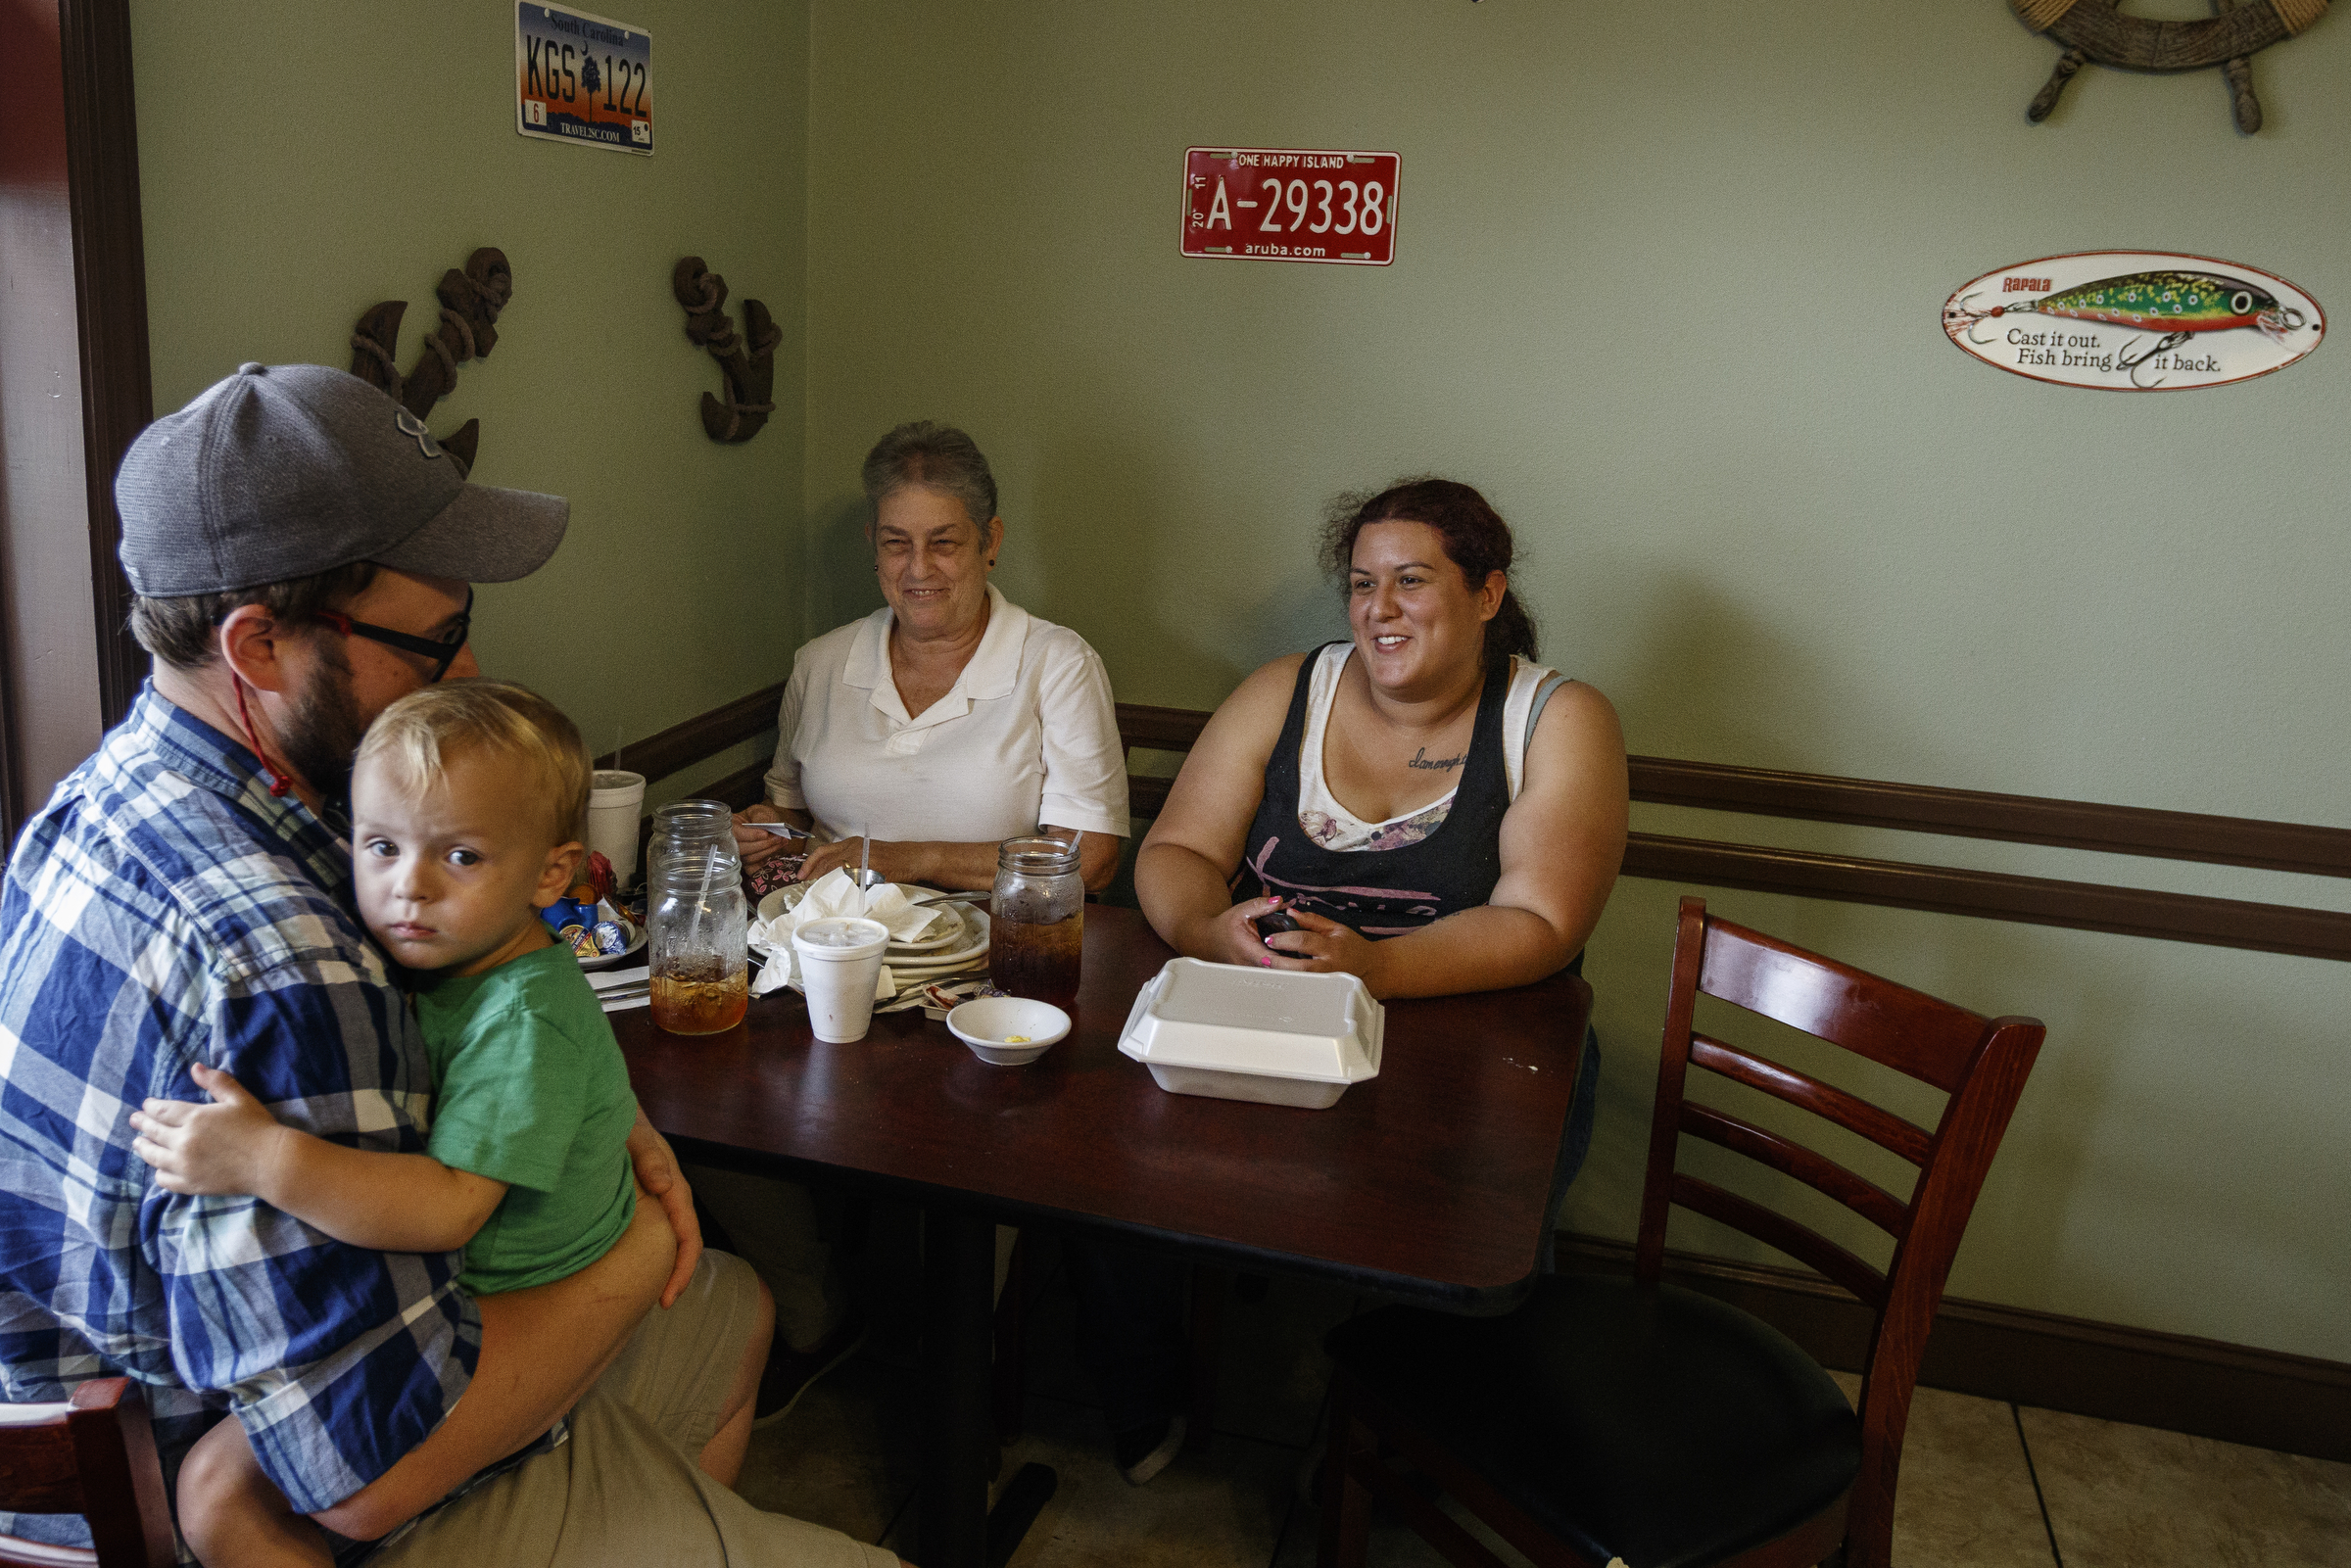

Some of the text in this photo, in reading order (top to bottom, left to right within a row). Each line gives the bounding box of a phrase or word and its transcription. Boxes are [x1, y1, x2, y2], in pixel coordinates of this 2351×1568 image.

[551, 14, 624, 47] South Carolina
[527, 34, 648, 118] KGS 122
[533, 103, 540, 122] 6
[560, 122, 620, 143] TRAVEL2SC.COM
[633, 125, 642, 136] 15
[1238, 154, 1344, 168] ONE HAPPY ISLAND
[1192, 176, 1206, 227] 20 11
[1206, 176, 1384, 236] A-29338
[1245, 243, 1326, 257] aruba.com
[2006, 328, 2101, 349] Cast it out.
[2017, 348, 2222, 373] Fish bring it back.
